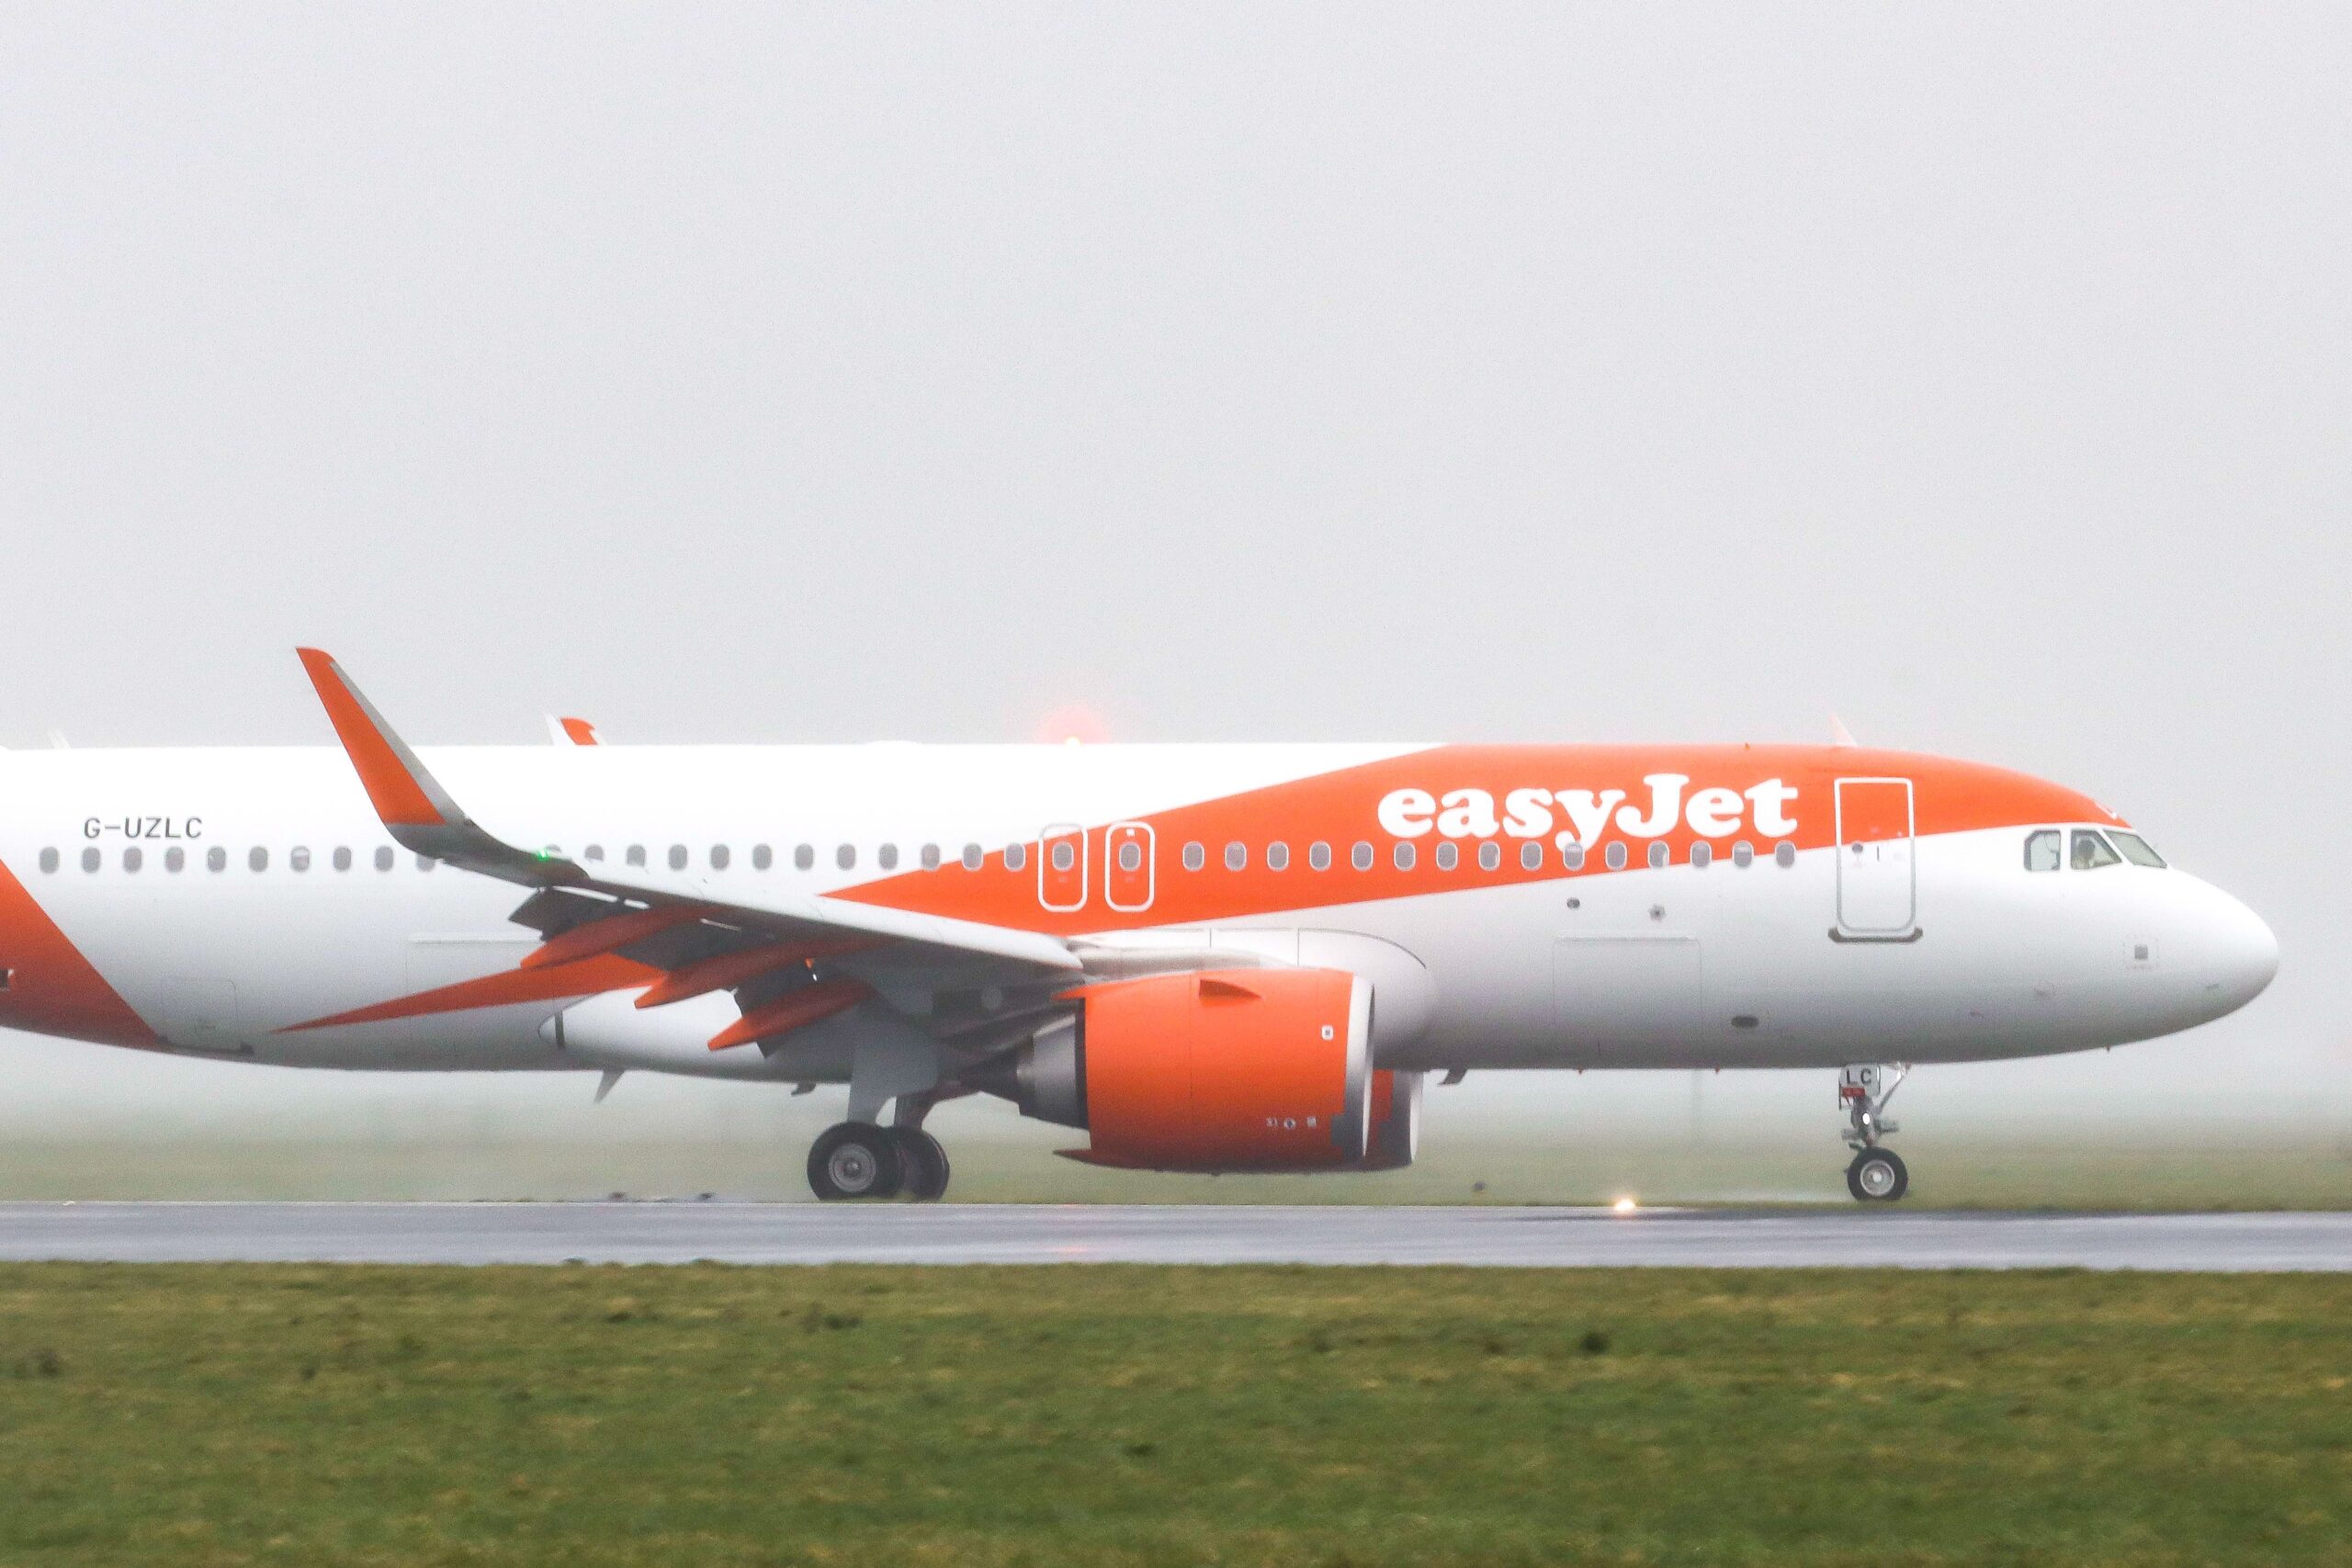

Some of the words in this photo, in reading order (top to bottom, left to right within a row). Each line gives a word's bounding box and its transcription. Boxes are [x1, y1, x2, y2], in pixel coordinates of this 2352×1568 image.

[1377, 773, 1799, 852] easyJet
[84, 818, 202, 839] G-UZLC
[1847, 1068, 1871, 1085] LC
